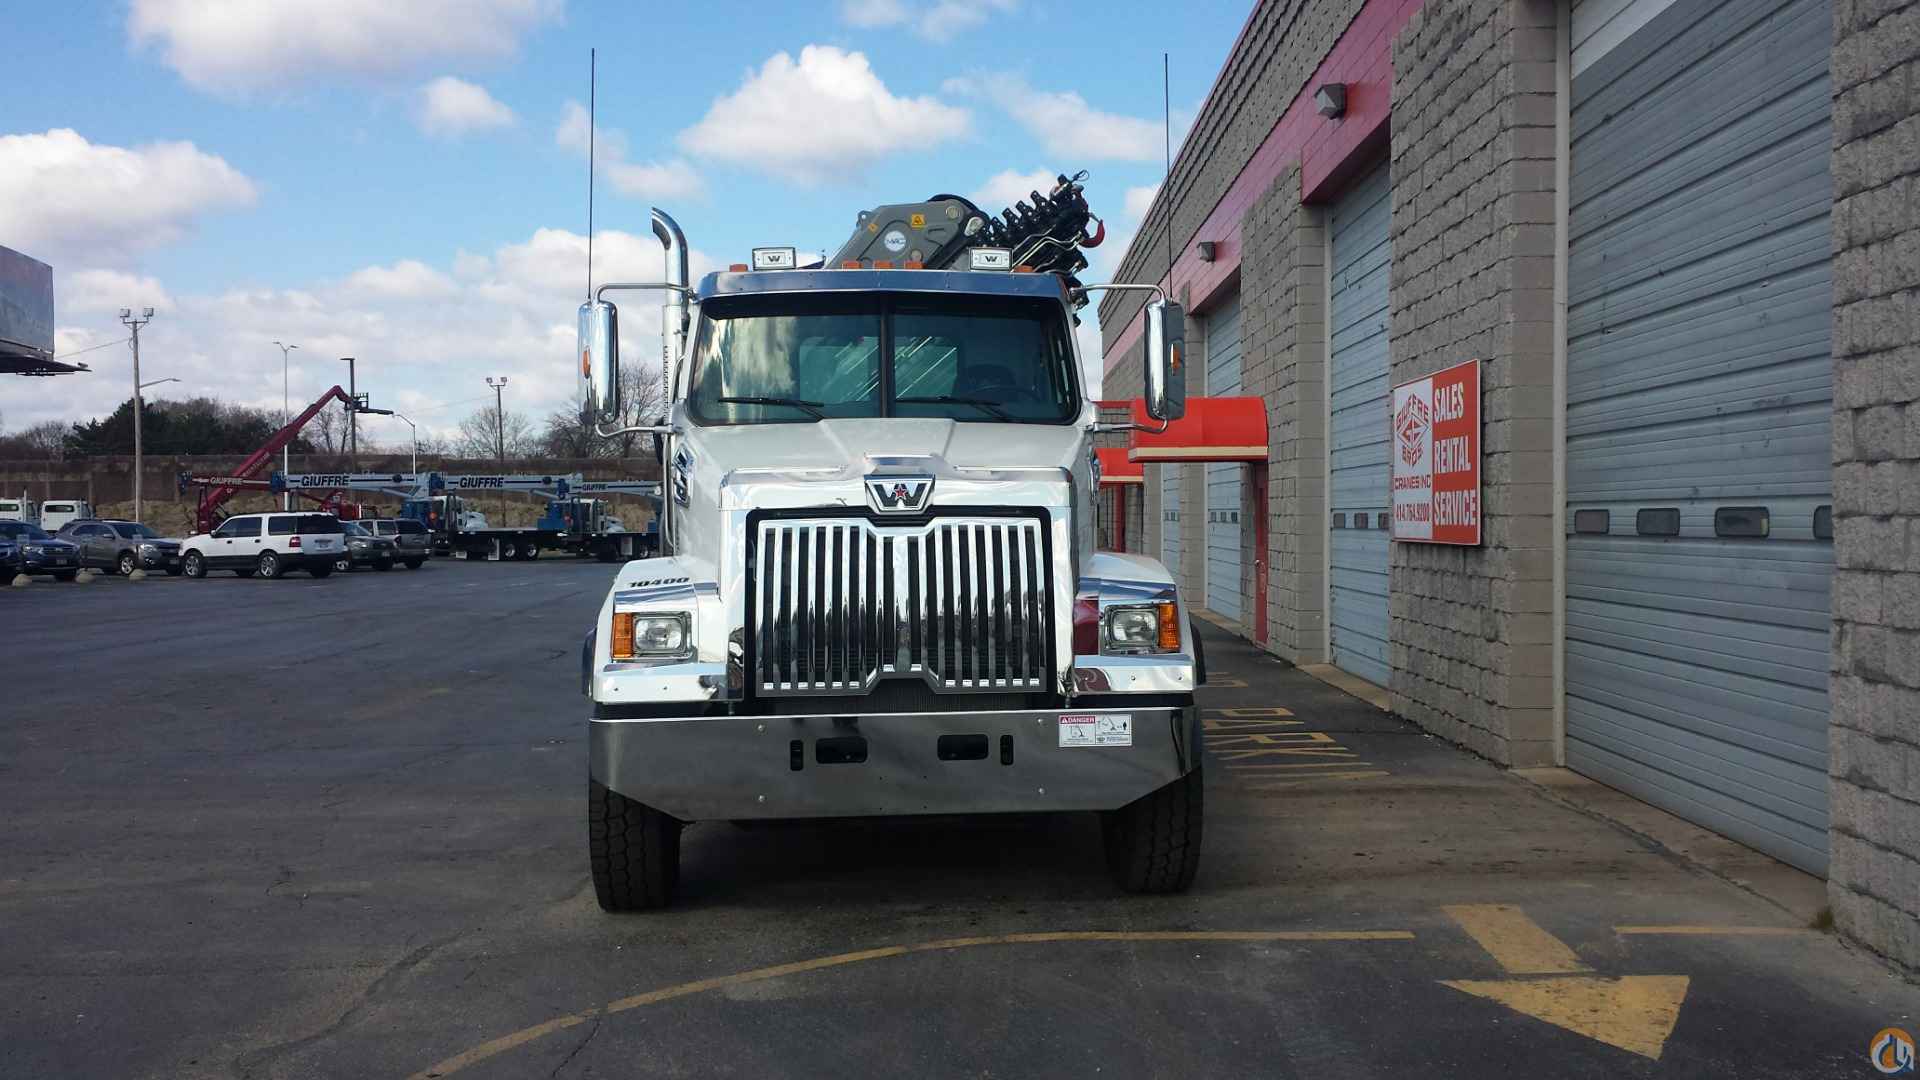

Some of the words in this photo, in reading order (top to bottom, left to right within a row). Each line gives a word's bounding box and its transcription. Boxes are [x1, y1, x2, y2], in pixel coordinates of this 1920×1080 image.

[1434, 382, 1464, 424] SALES
[1434, 435, 1472, 474] RENTAL
[301, 475, 349, 487] GIUFFRE
[459, 477, 504, 488] GIUFFRE
[1434, 489, 1477, 526] SERVICE
